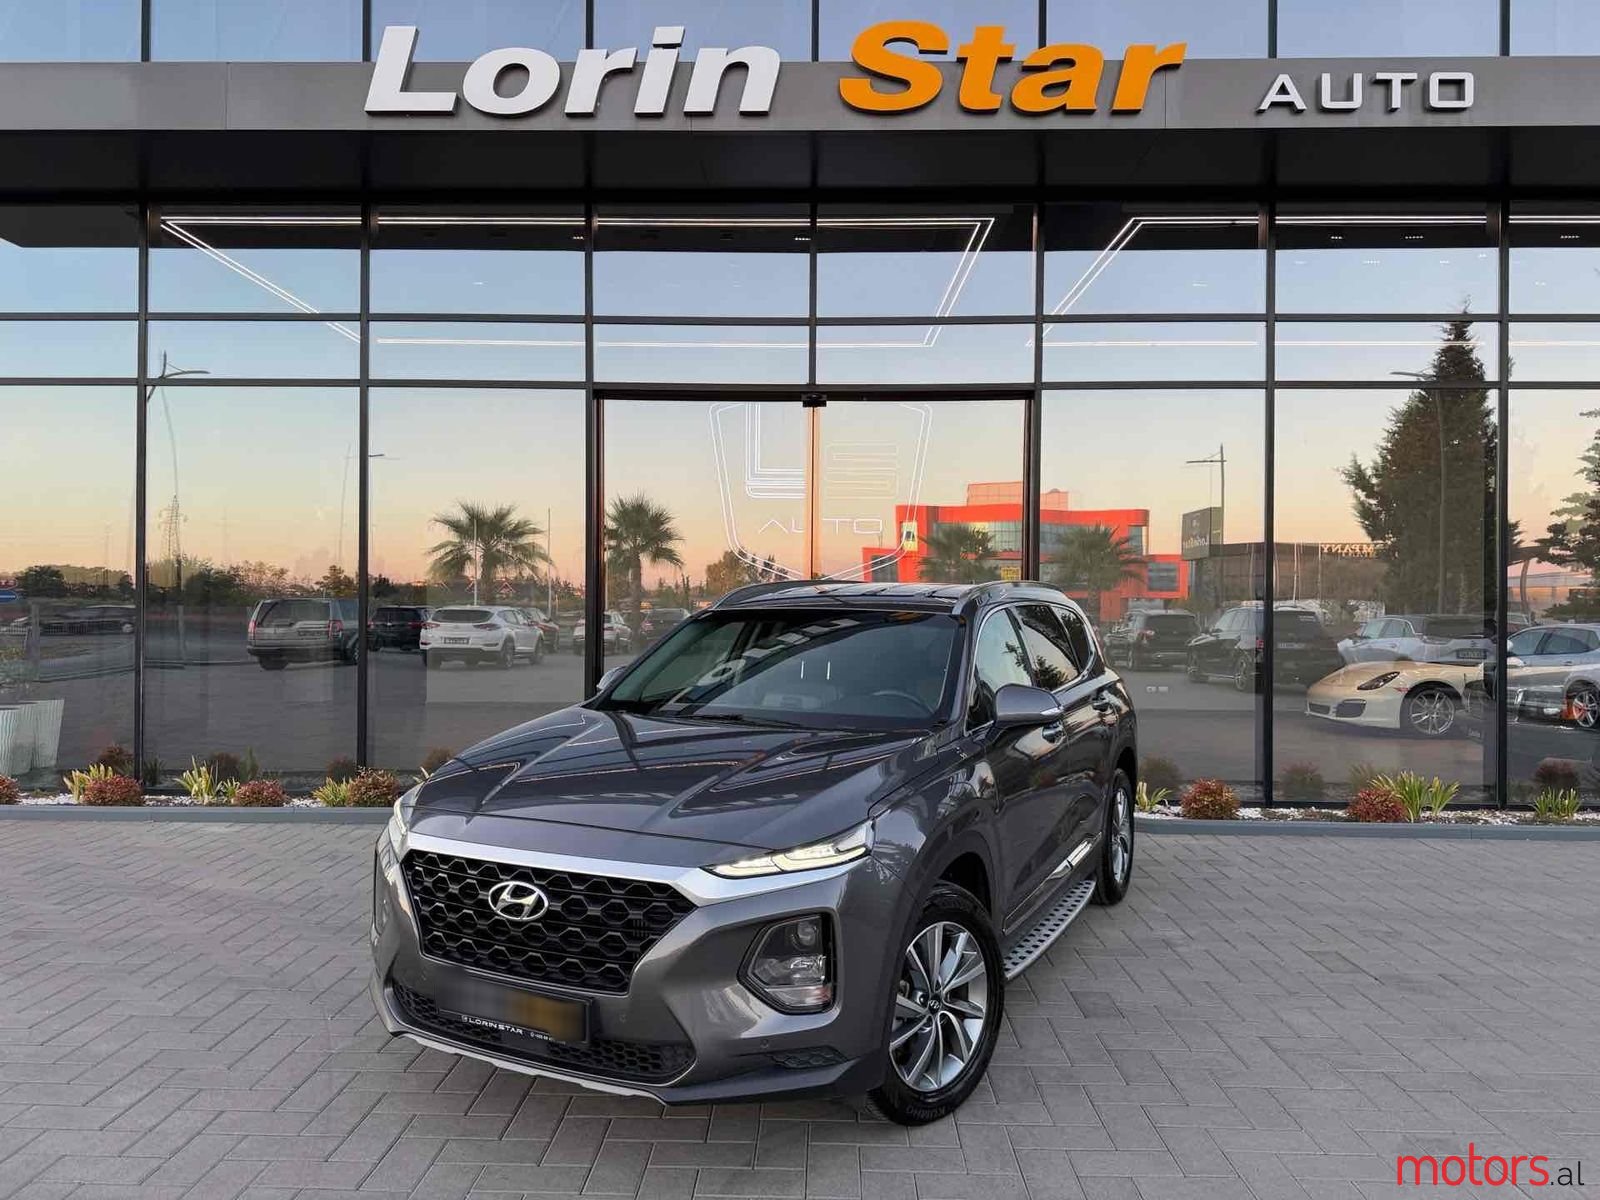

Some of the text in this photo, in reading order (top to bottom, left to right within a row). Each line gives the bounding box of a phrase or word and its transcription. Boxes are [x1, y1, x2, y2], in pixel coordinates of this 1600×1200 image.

[364, 20, 1475, 117] Lorin Star AUTO
